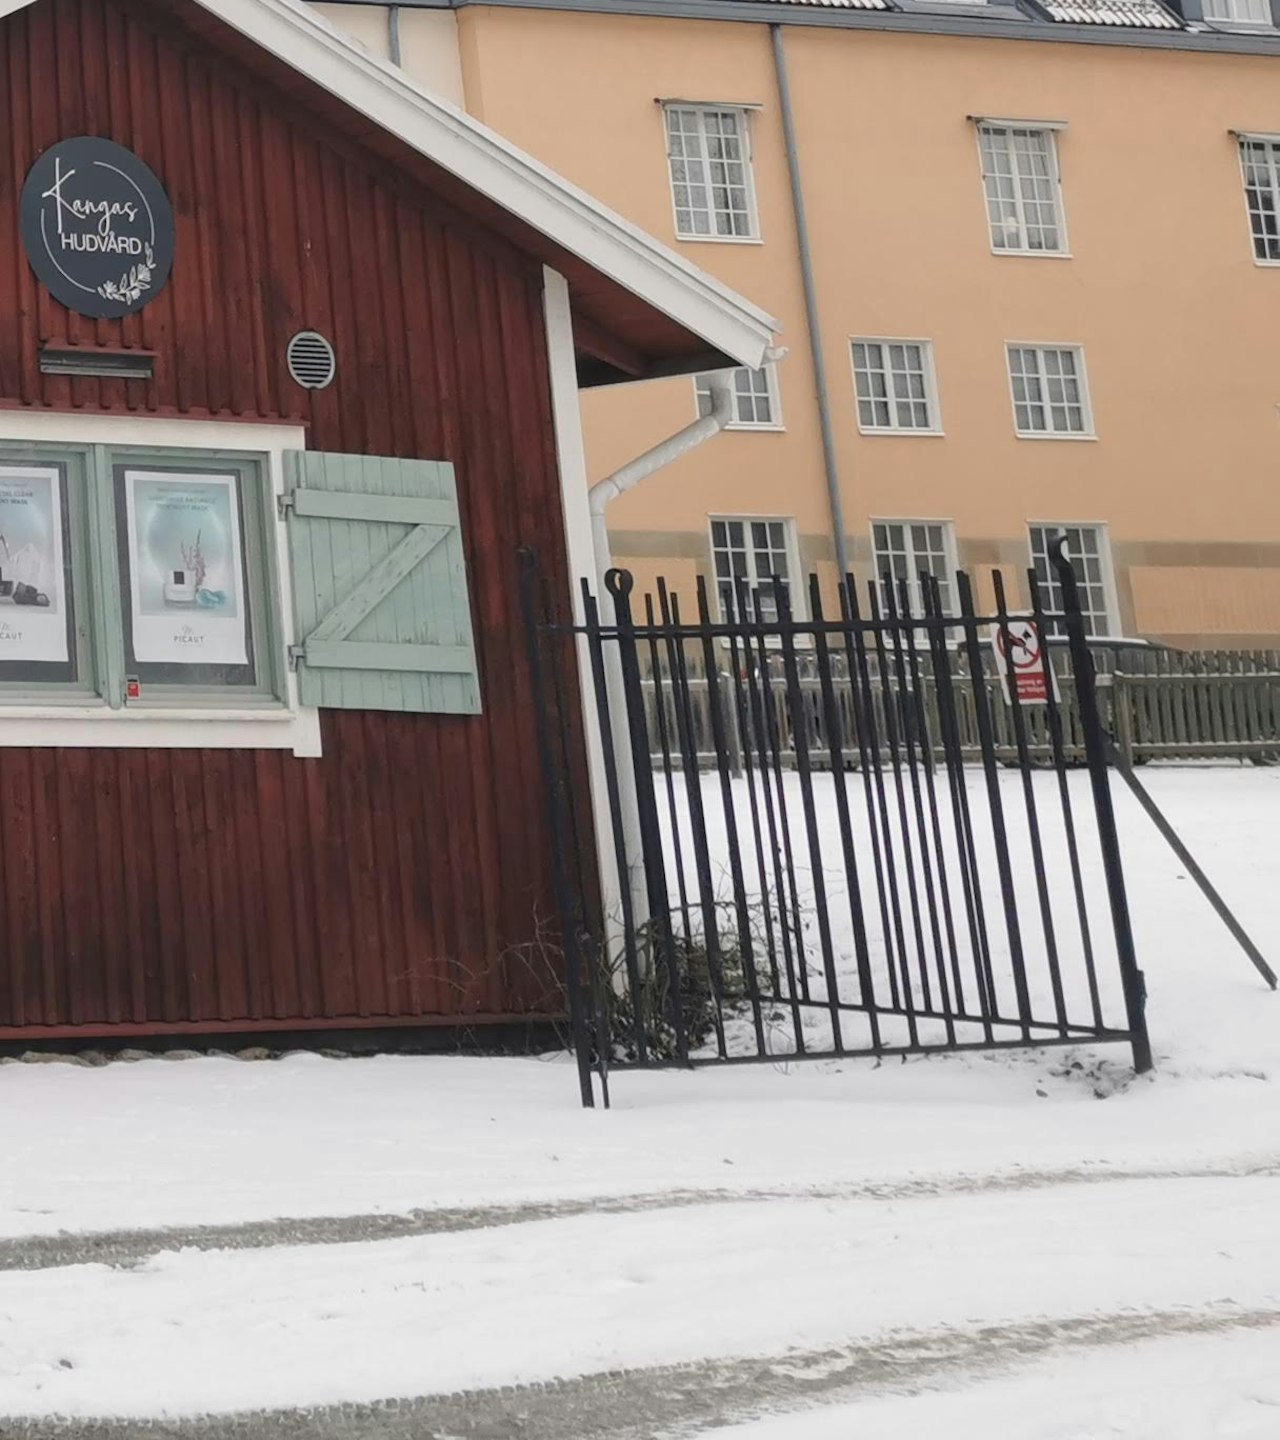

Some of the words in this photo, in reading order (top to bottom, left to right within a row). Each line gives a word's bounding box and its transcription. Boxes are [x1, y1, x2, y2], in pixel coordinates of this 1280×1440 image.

[42, 157, 138, 236] Kangas
[61, 231, 142, 255] HUDVÅRD
[173, 635, 204, 643] PICAUT
